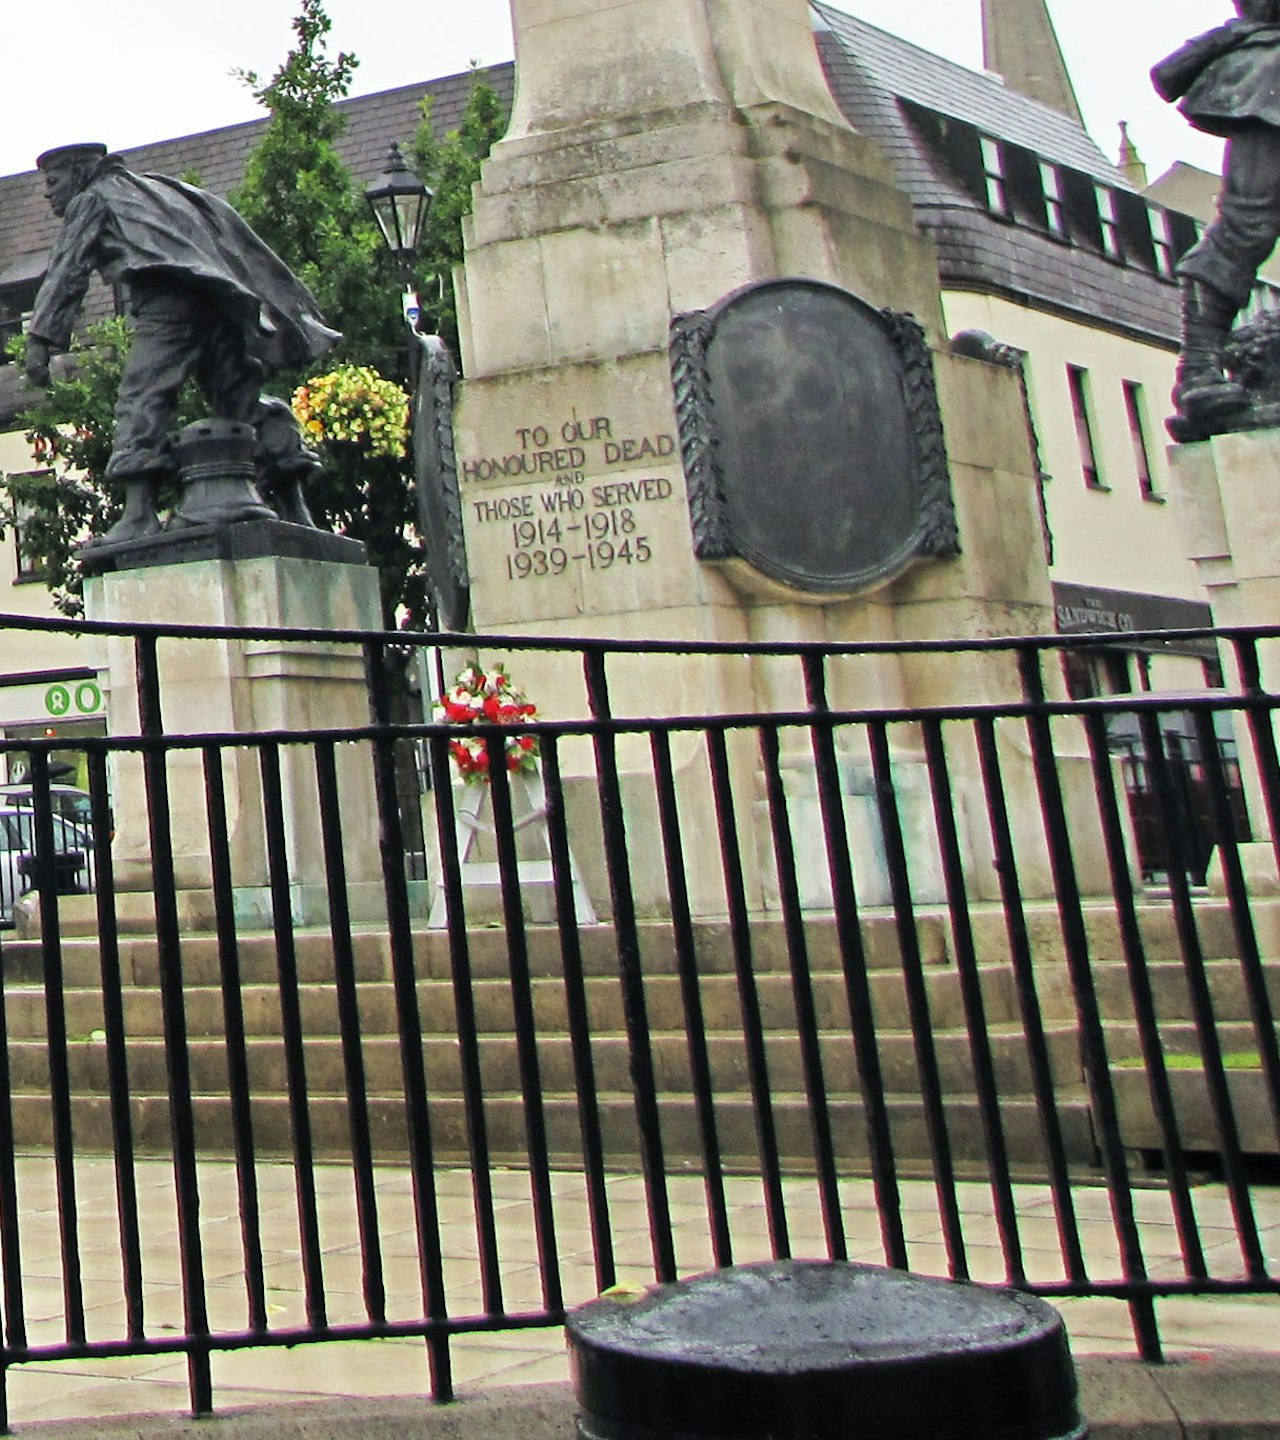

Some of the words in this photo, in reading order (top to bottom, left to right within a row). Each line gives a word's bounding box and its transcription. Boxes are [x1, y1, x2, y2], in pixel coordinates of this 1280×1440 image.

[515, 426, 549, 449] TO
[561, 416, 612, 443] OUR
[462, 447, 585, 483] HONOURED
[605, 435, 675, 464] DEAD
[555, 471, 585, 487] AND
[473, 496, 534, 522] THOSE
[541, 488, 584, 513] WHO
[592, 478, 672, 507] SERVED
[512, 508, 636, 548] 1914-1918
[506, 536, 651, 580] 1939-1945
